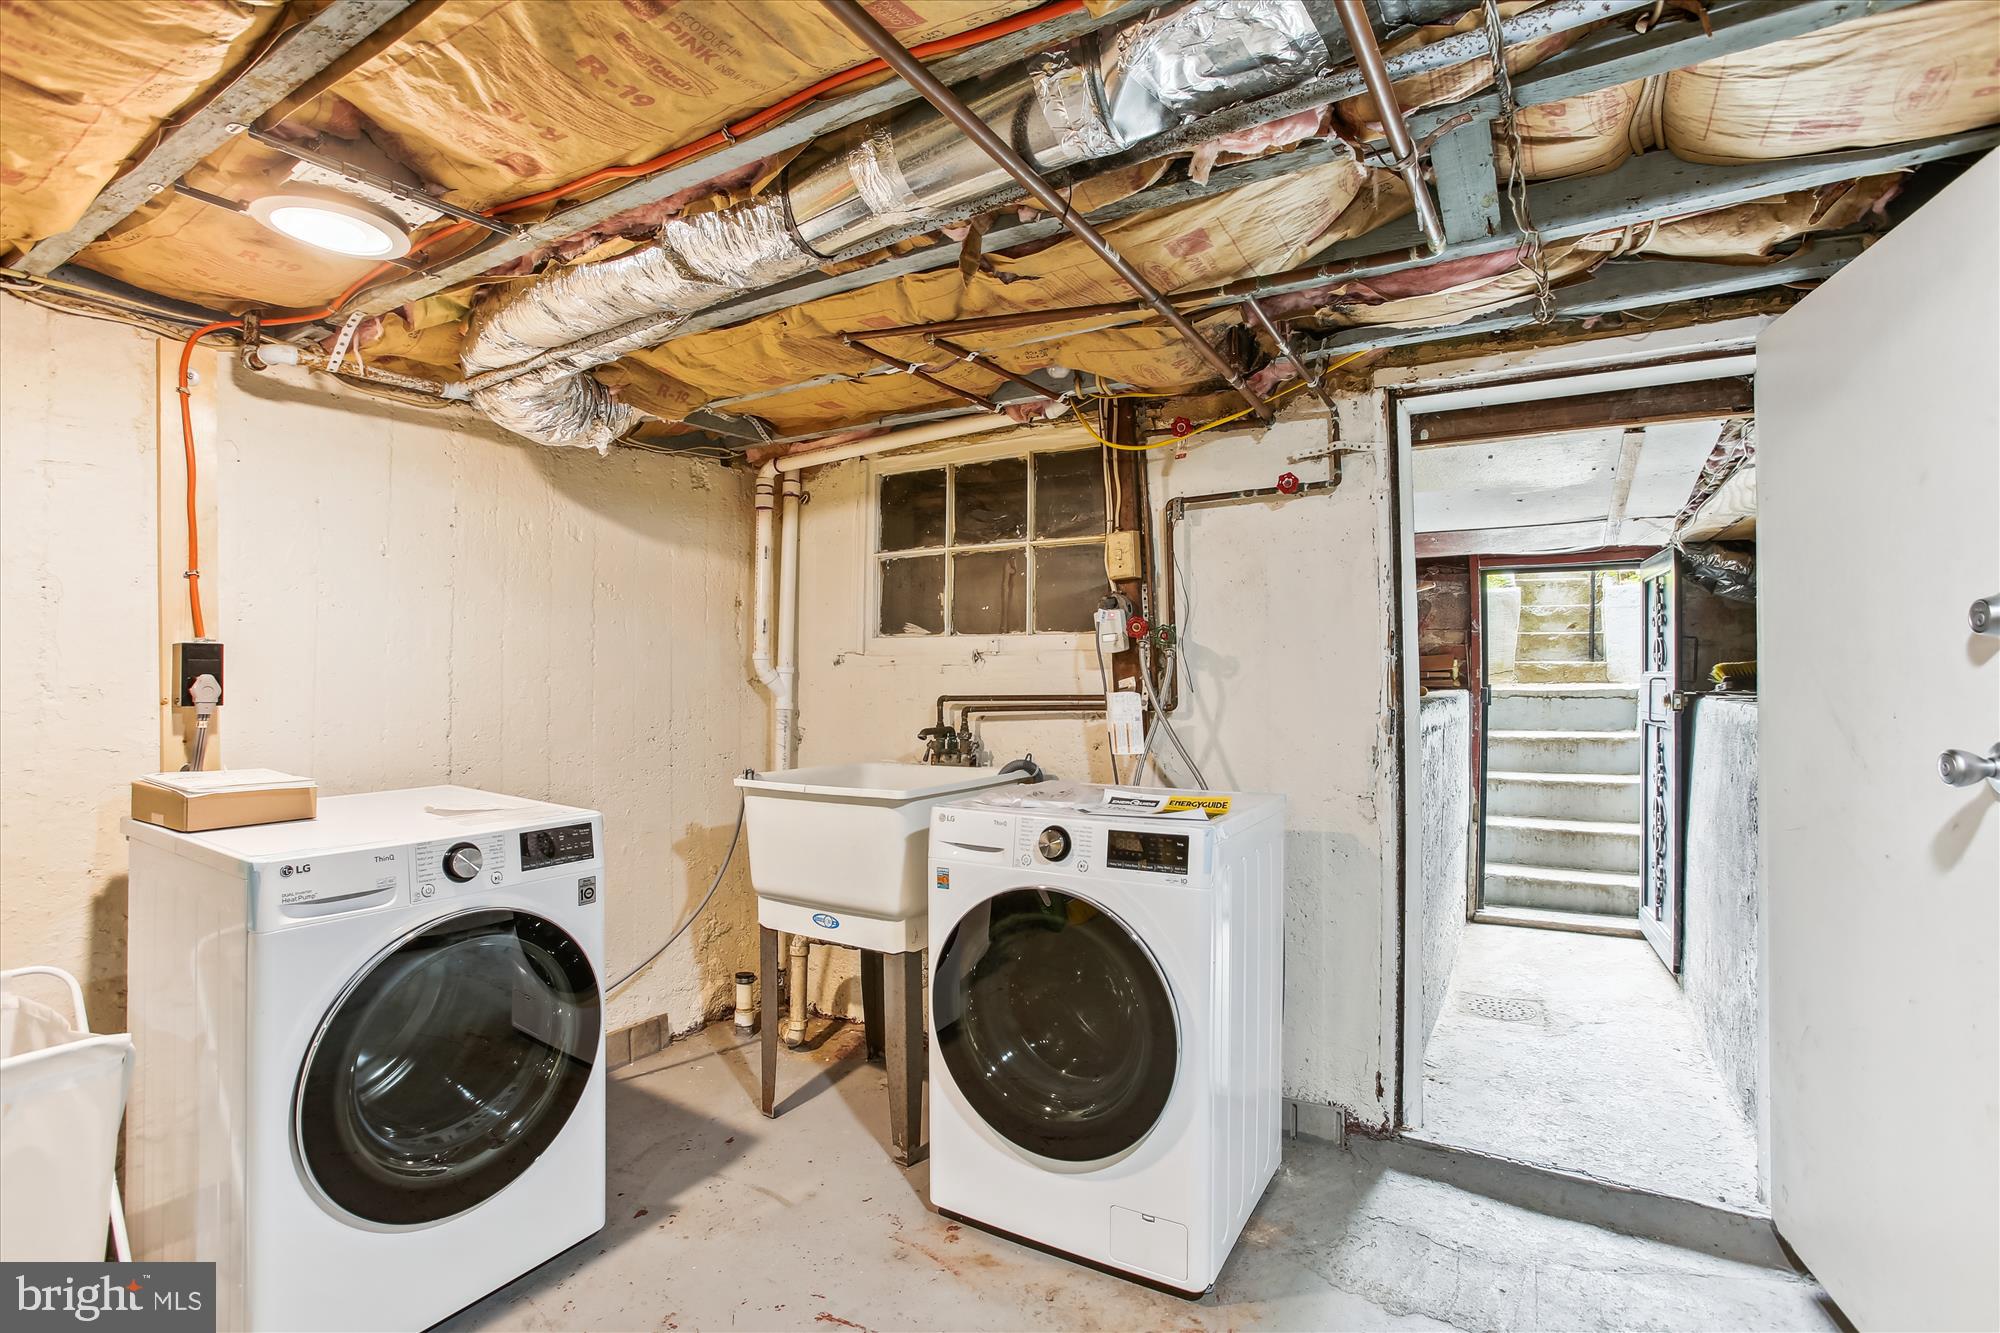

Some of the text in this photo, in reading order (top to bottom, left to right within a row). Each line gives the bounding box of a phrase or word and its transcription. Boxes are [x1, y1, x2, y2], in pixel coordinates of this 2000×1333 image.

[659, 21, 722, 66] PINK
[575, 54, 656, 107] R-19
[1168, 799, 1229, 809] ENERGYGUIDE
[374, 854, 395, 863] ThinQ
[296, 864, 311, 874] LG
